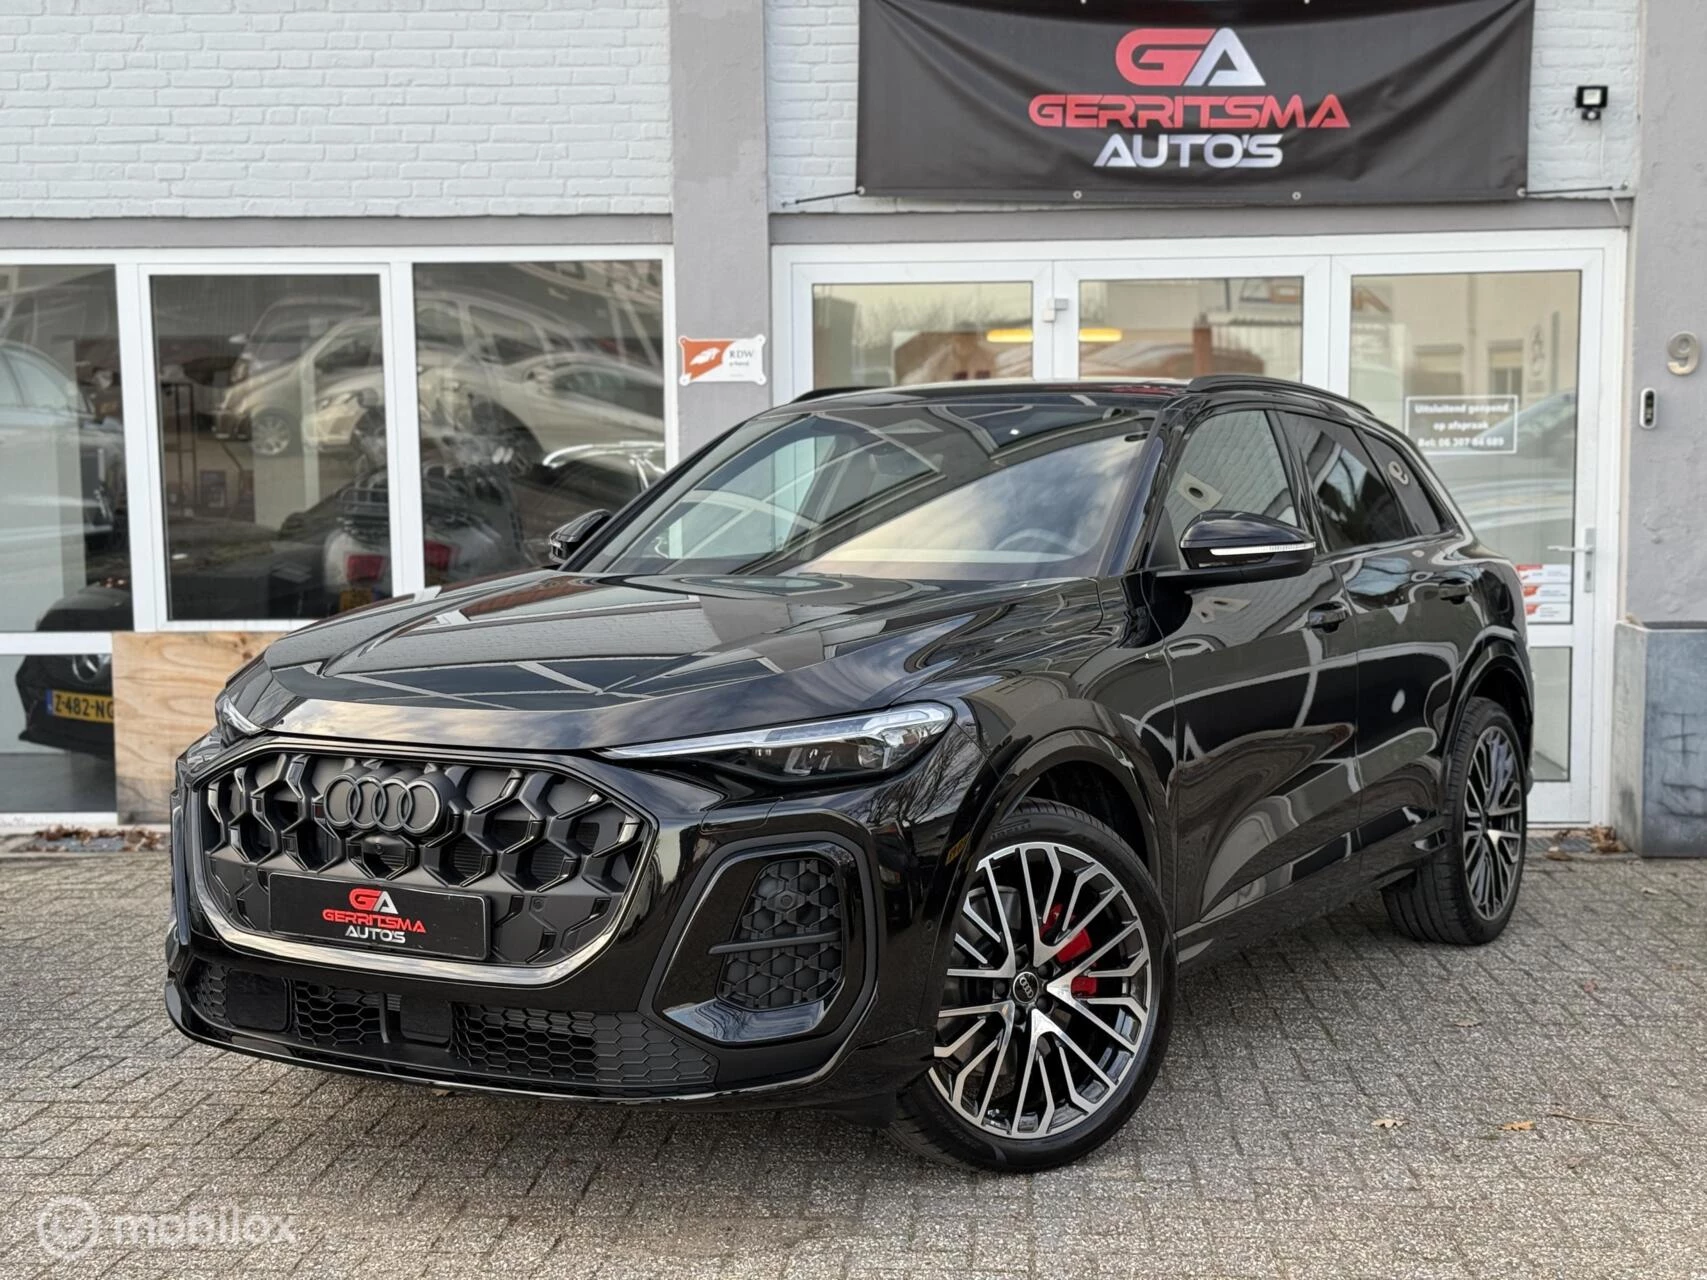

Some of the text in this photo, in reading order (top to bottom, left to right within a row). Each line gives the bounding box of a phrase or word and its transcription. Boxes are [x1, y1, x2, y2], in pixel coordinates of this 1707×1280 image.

[1115, 28, 1266, 86] GA
[1028, 94, 1350, 128] GERRITSMA
[1093, 133, 1283, 168] AUTO'S
[1667, 331, 1699, 376] 9
[349, 888, 398, 914] GA
[322, 908, 426, 933] GERRITSMA
[345, 925, 406, 943] AUTO'S
